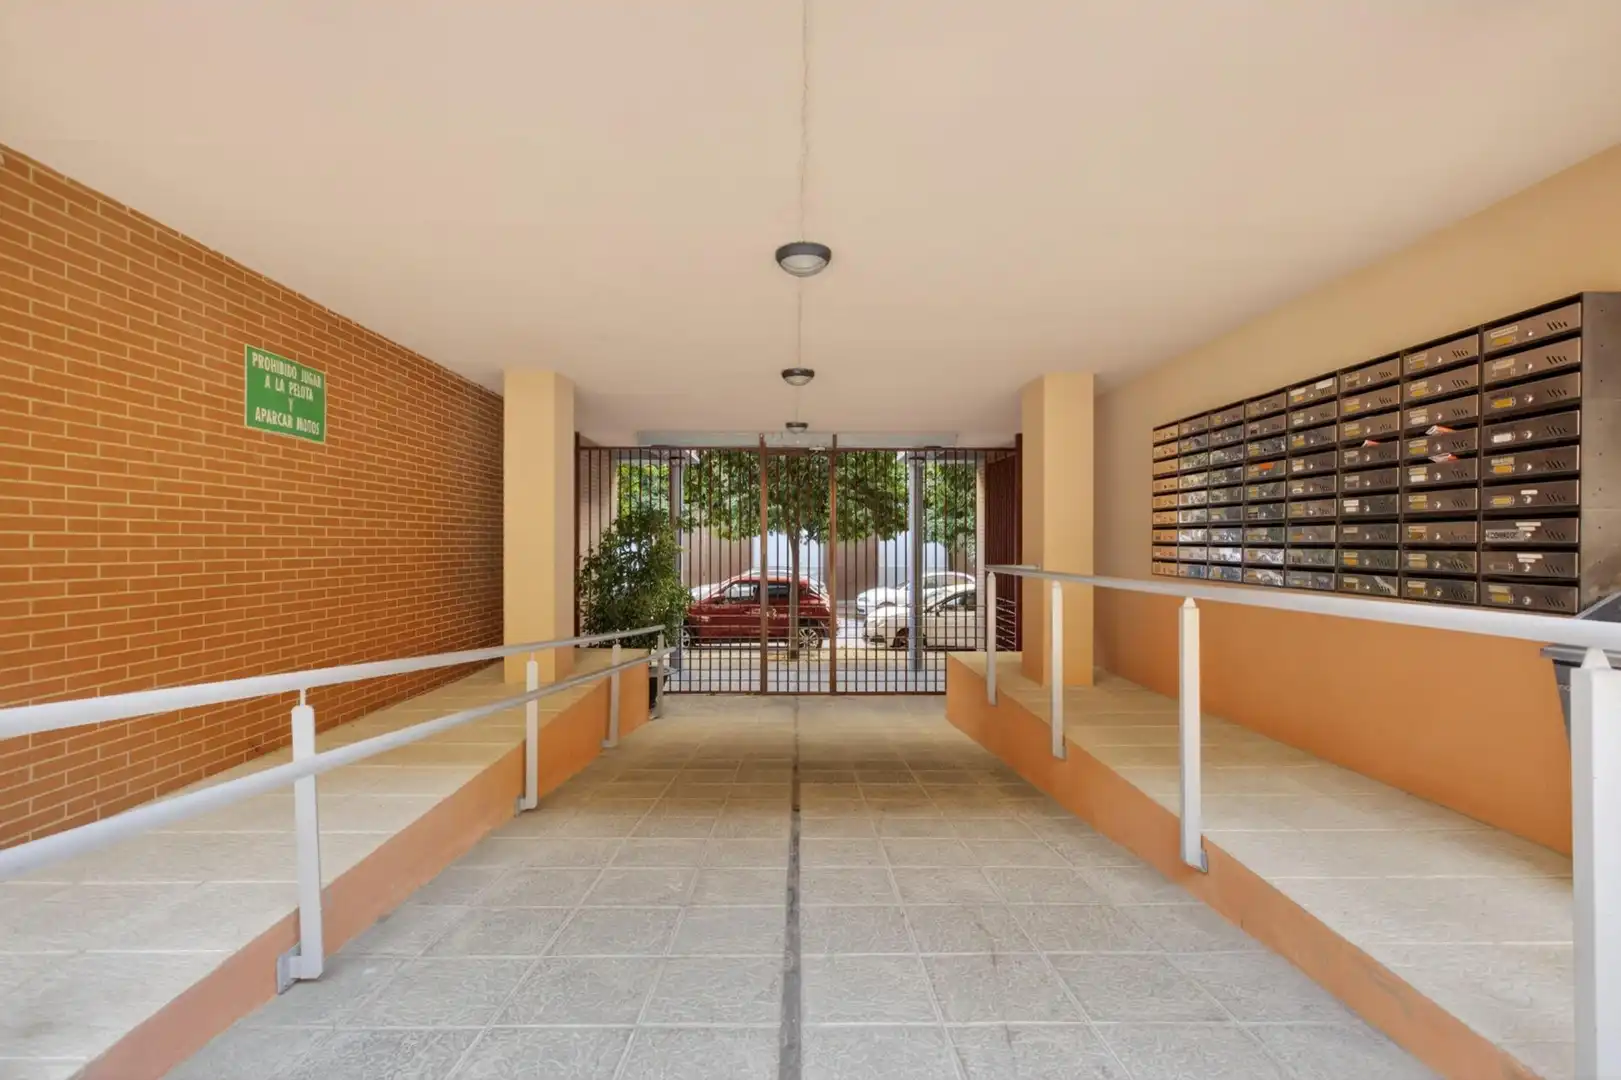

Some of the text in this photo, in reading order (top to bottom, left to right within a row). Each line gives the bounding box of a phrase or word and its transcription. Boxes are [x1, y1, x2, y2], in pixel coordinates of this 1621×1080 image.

[252, 352, 321, 388] PROHIBIDO JUGAR
[264, 374, 313, 401] A LA PELOTA
[288, 397, 295, 412] Y
[255, 406, 320, 435] APARCAR MOTOS
